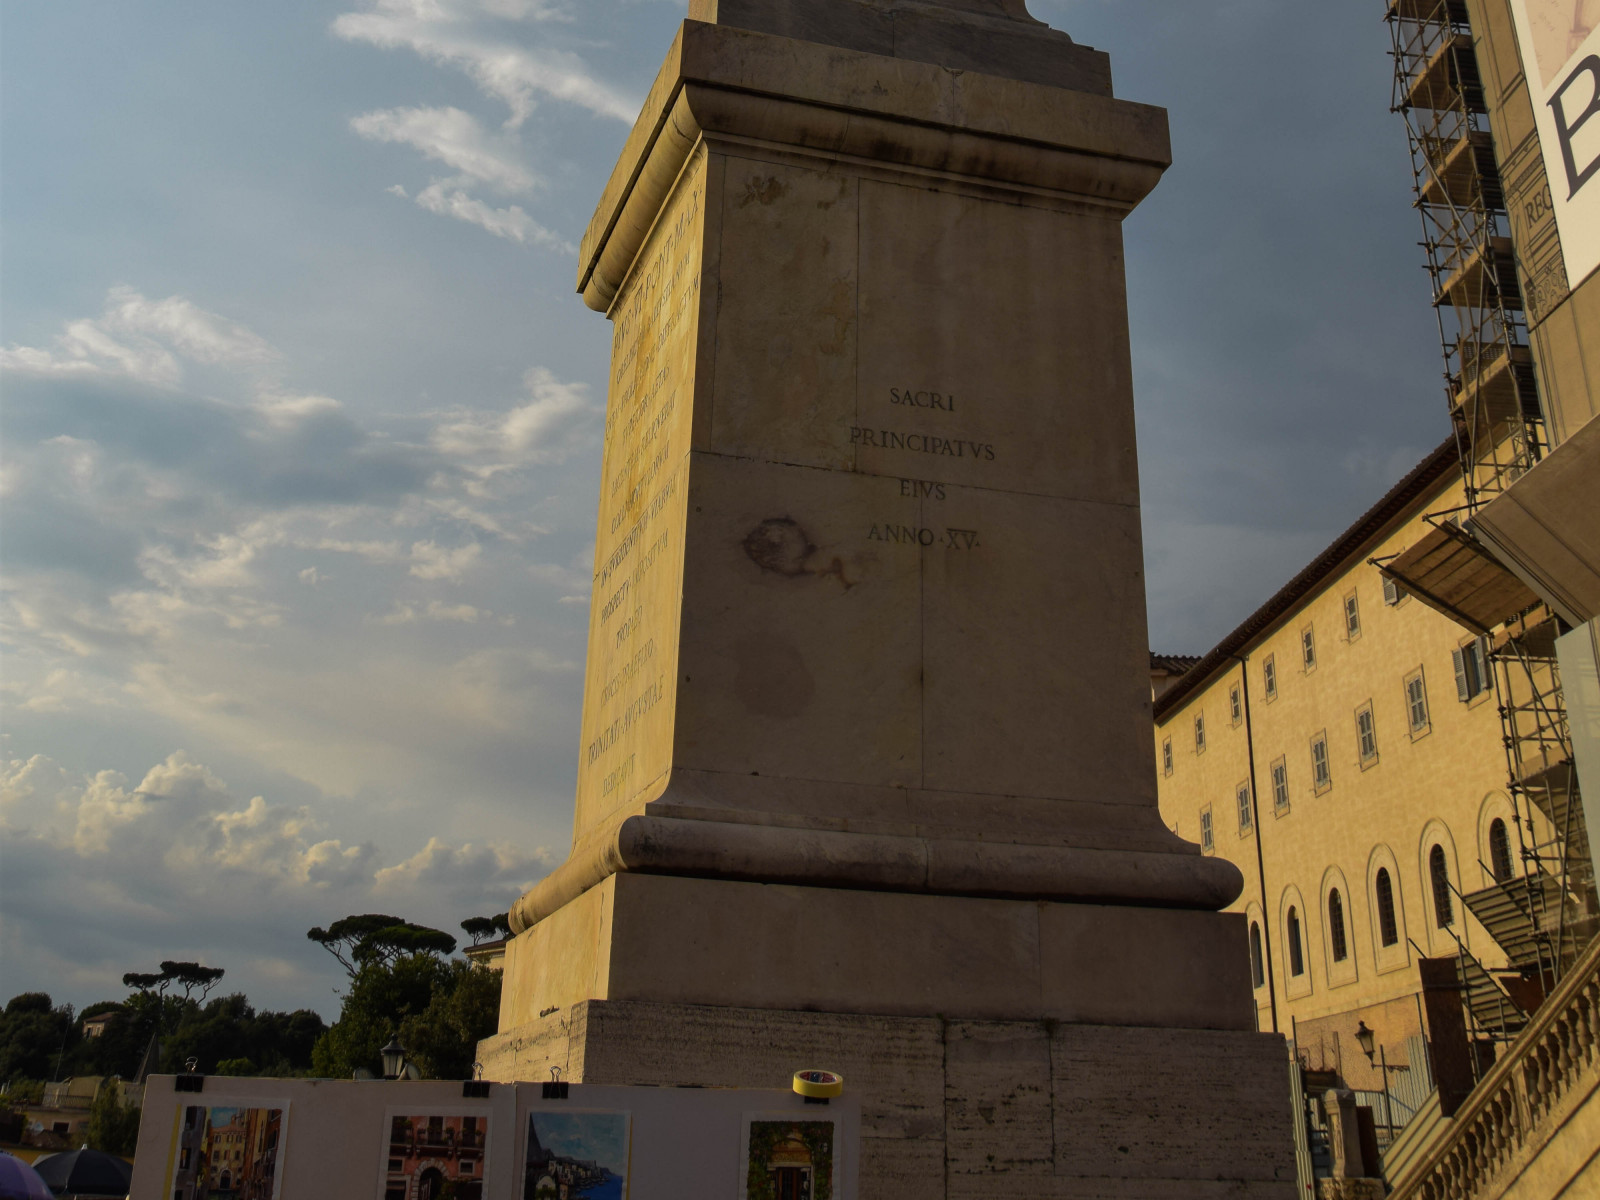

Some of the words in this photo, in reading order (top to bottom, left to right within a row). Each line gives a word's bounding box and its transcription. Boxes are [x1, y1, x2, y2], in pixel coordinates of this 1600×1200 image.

[1546, 54, 1600, 202] B
[890, 387, 955, 411] SACRI
[850, 427, 995, 460] PRINCIPATVS
[900, 477, 946, 500] EIVS
[867, 524, 934, 546] ANNO
